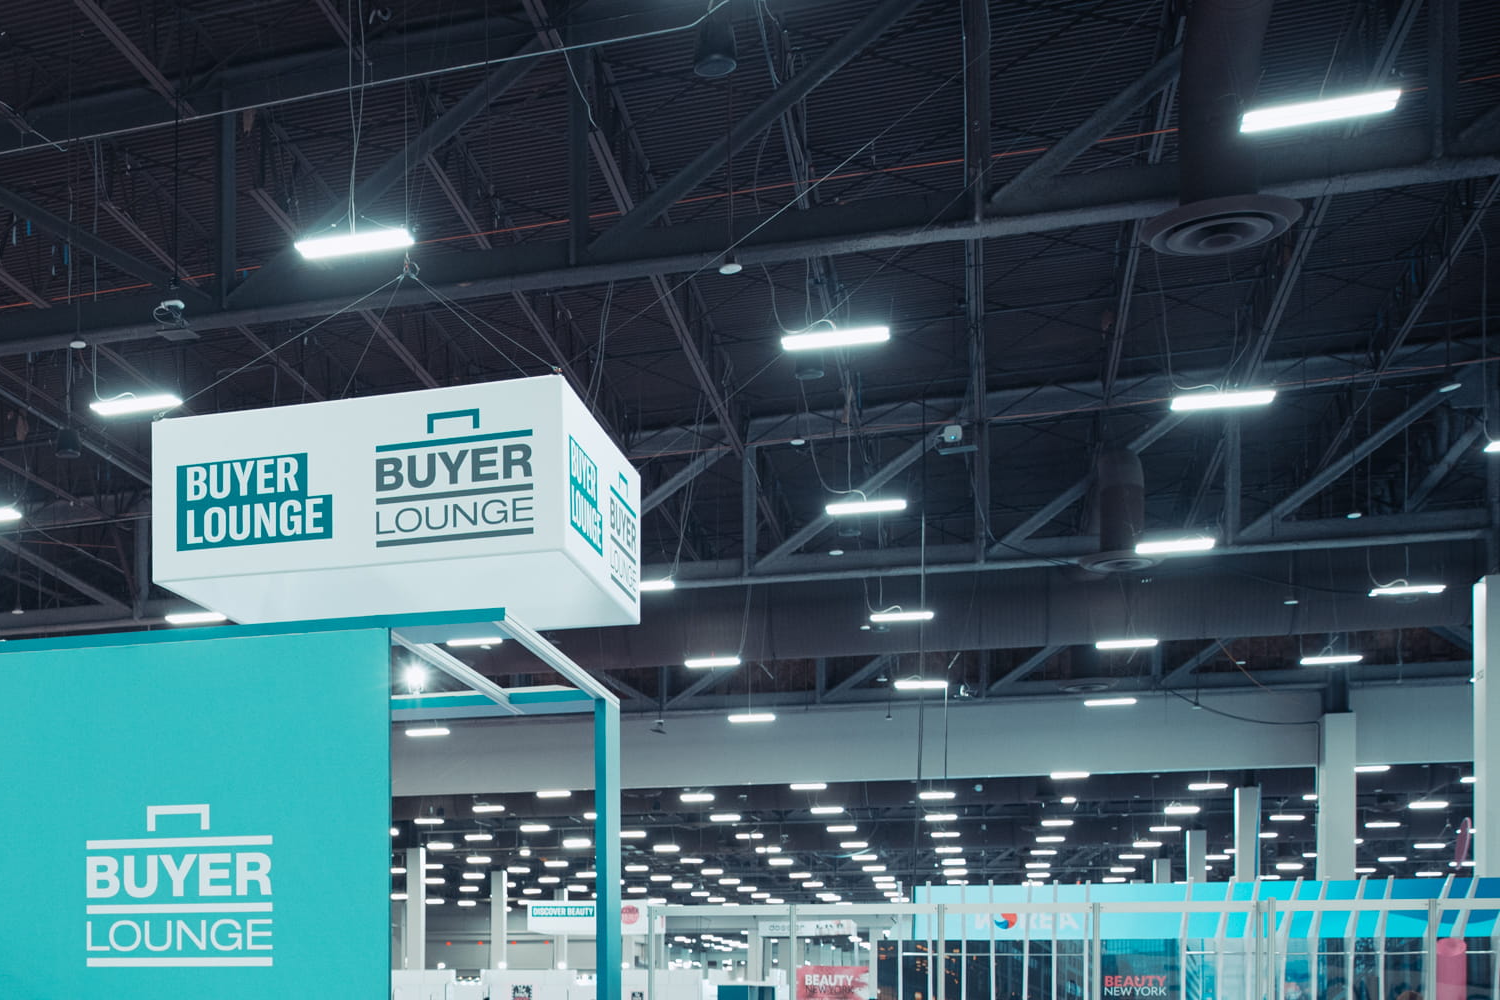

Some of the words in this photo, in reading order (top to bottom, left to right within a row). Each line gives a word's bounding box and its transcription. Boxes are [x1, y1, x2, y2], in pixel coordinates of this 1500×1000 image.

[185, 457, 299, 501] BUYER
[375, 443, 533, 492] BUYER
[572, 444, 597, 501] BUYER
[185, 496, 324, 544] LOUNGE
[375, 497, 534, 535] LOUNGE
[572, 484, 602, 548] LOUNGE
[610, 497, 637, 554] BUYER
[610, 548, 637, 593] LOUNGE
[86, 852, 272, 898] BUYER
[532, 907, 566, 916] DISCOVER
[567, 907, 594, 916] BEAUTY
[86, 918, 273, 952] LOUNGE
[804, 974, 854, 986] BEAUTY
[805, 985, 826, 994] NEW
[1104, 975, 1167, 987] BEAUTY
[1104, 986, 1132, 997] NEW
[1133, 986, 1167, 997] YORK
